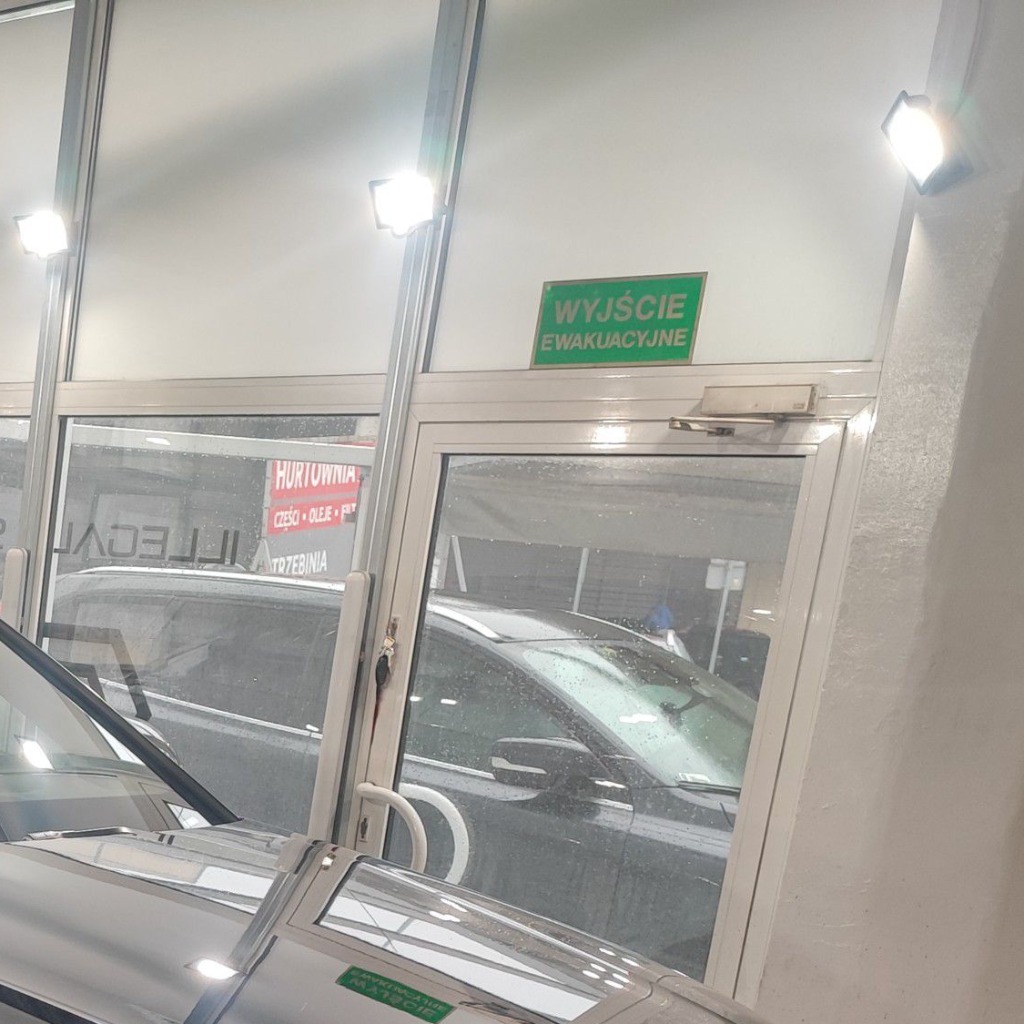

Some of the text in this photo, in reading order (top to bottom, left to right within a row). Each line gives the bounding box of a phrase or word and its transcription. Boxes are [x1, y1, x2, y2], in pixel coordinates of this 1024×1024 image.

[554, 290, 687, 325] WYJŚCIE
[541, 328, 688, 351] EWAKUACYJNE
[275, 460, 356, 491] HURTOWNIA
[309, 505, 333, 524] OLEJE
